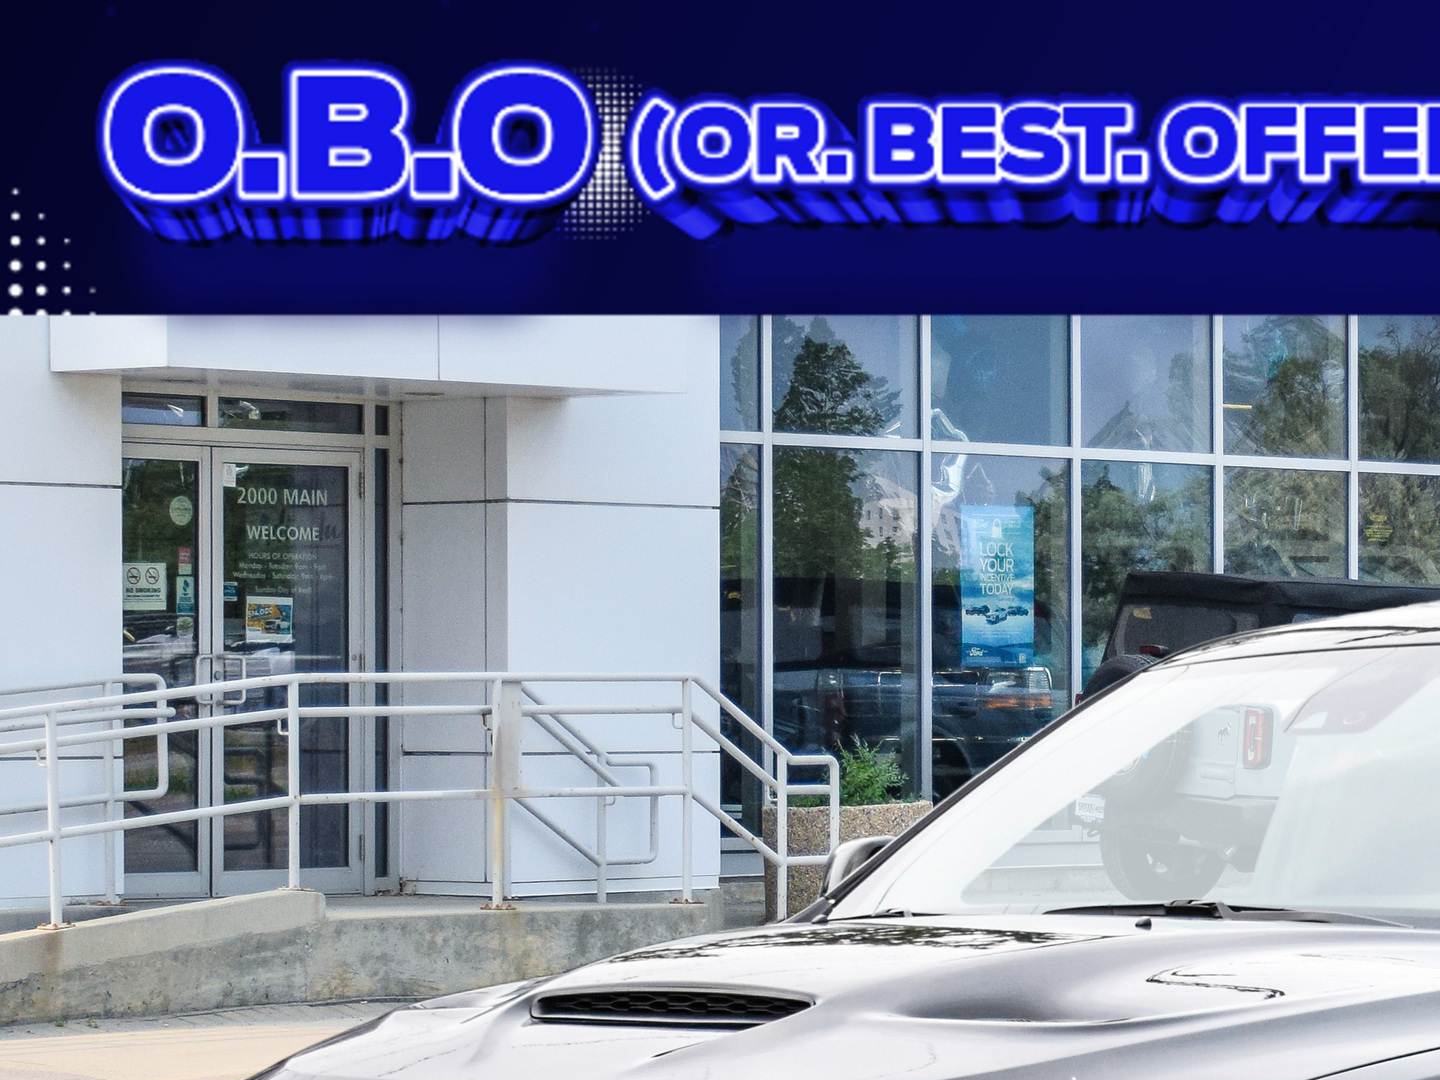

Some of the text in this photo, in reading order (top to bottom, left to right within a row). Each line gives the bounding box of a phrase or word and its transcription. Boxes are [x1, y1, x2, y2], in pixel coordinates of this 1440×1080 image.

[237, 487, 328, 507] 2000 MAIN
[246, 525, 320, 541] WELCOME
[248, 552, 271, 560] HOURS
[980, 541, 1014, 557] LOCK
[979, 558, 1015, 573] YOUR
[980, 583, 1013, 596] TODAY
